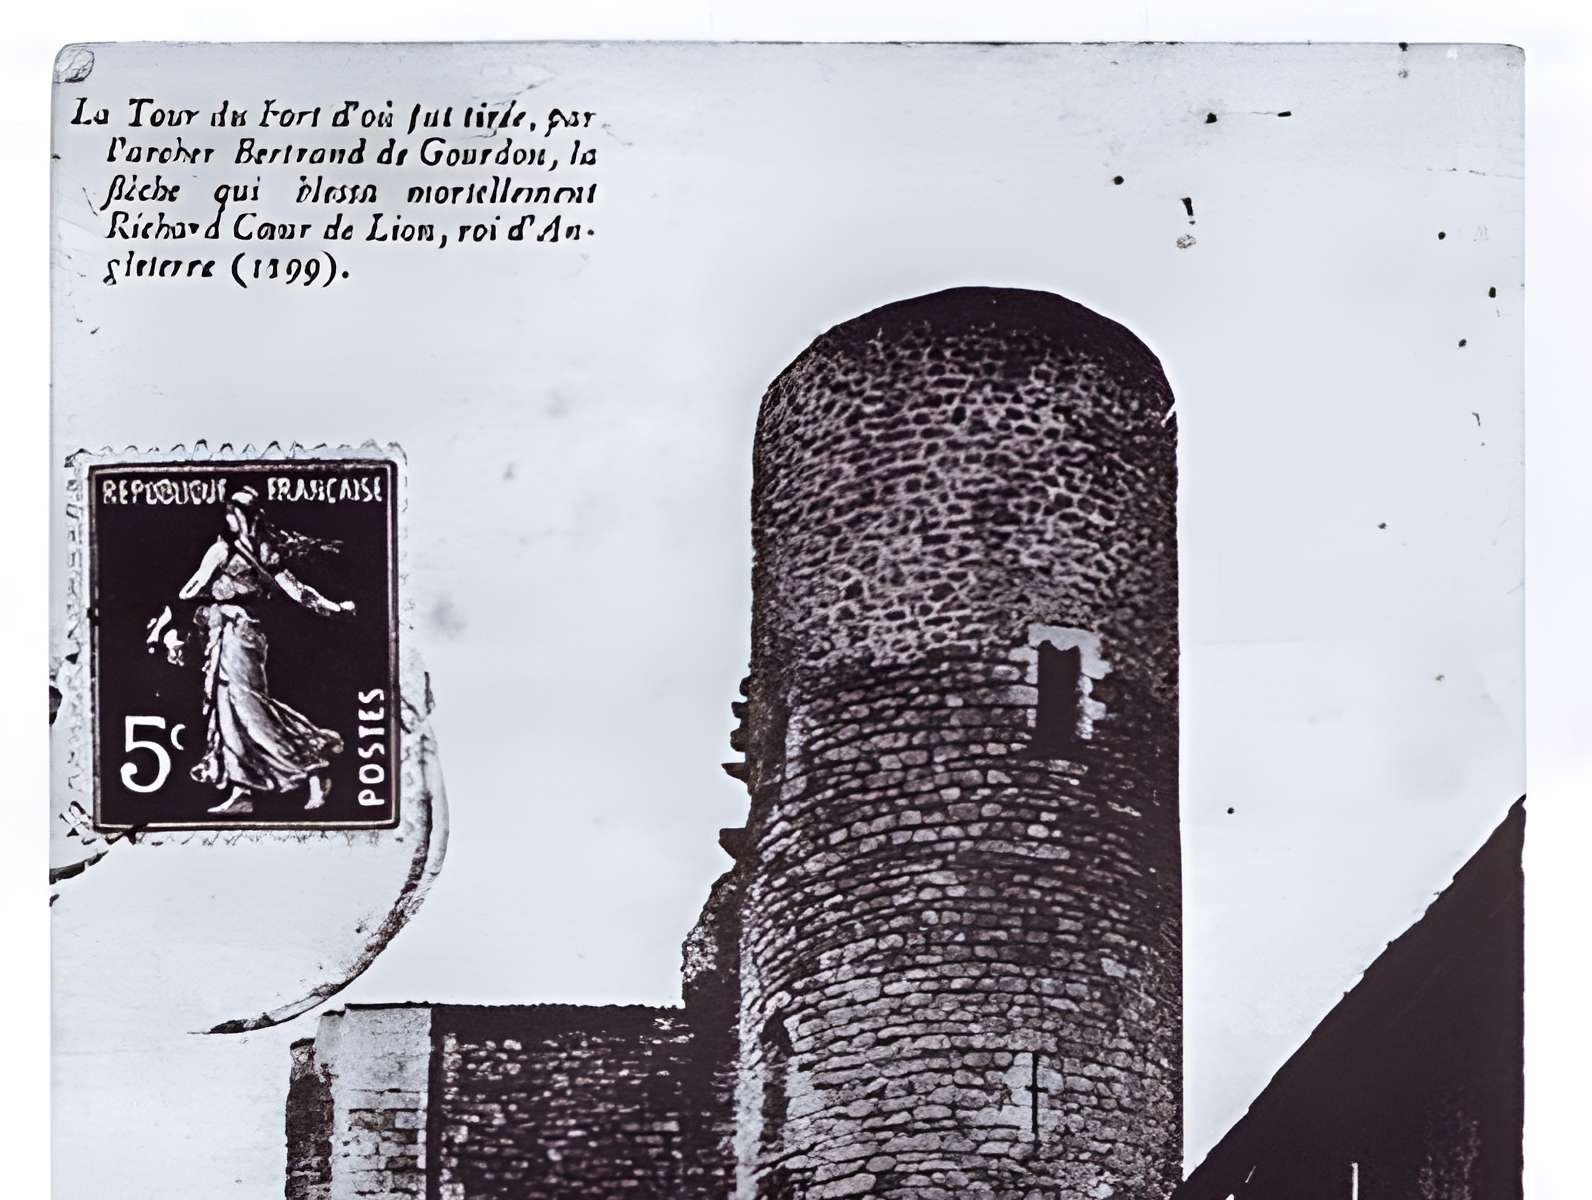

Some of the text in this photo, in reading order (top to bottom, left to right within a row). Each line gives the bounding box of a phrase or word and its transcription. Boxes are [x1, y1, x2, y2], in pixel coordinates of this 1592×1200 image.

[71, 97, 109, 125] La
[129, 99, 199, 127] Tour
[259, 100, 320, 127] Fort
[235, 138, 366, 164] Bertrand
[421, 137, 558, 171] Gourdon,
[571, 140, 596, 165] la
[214, 176, 260, 206] qui
[105, 206, 224, 240] Richard
[324, 213, 353, 240] de
[366, 213, 447, 248] Lion,
[458, 215, 498, 243] roi
[358, 688, 385, 807] POSTES
